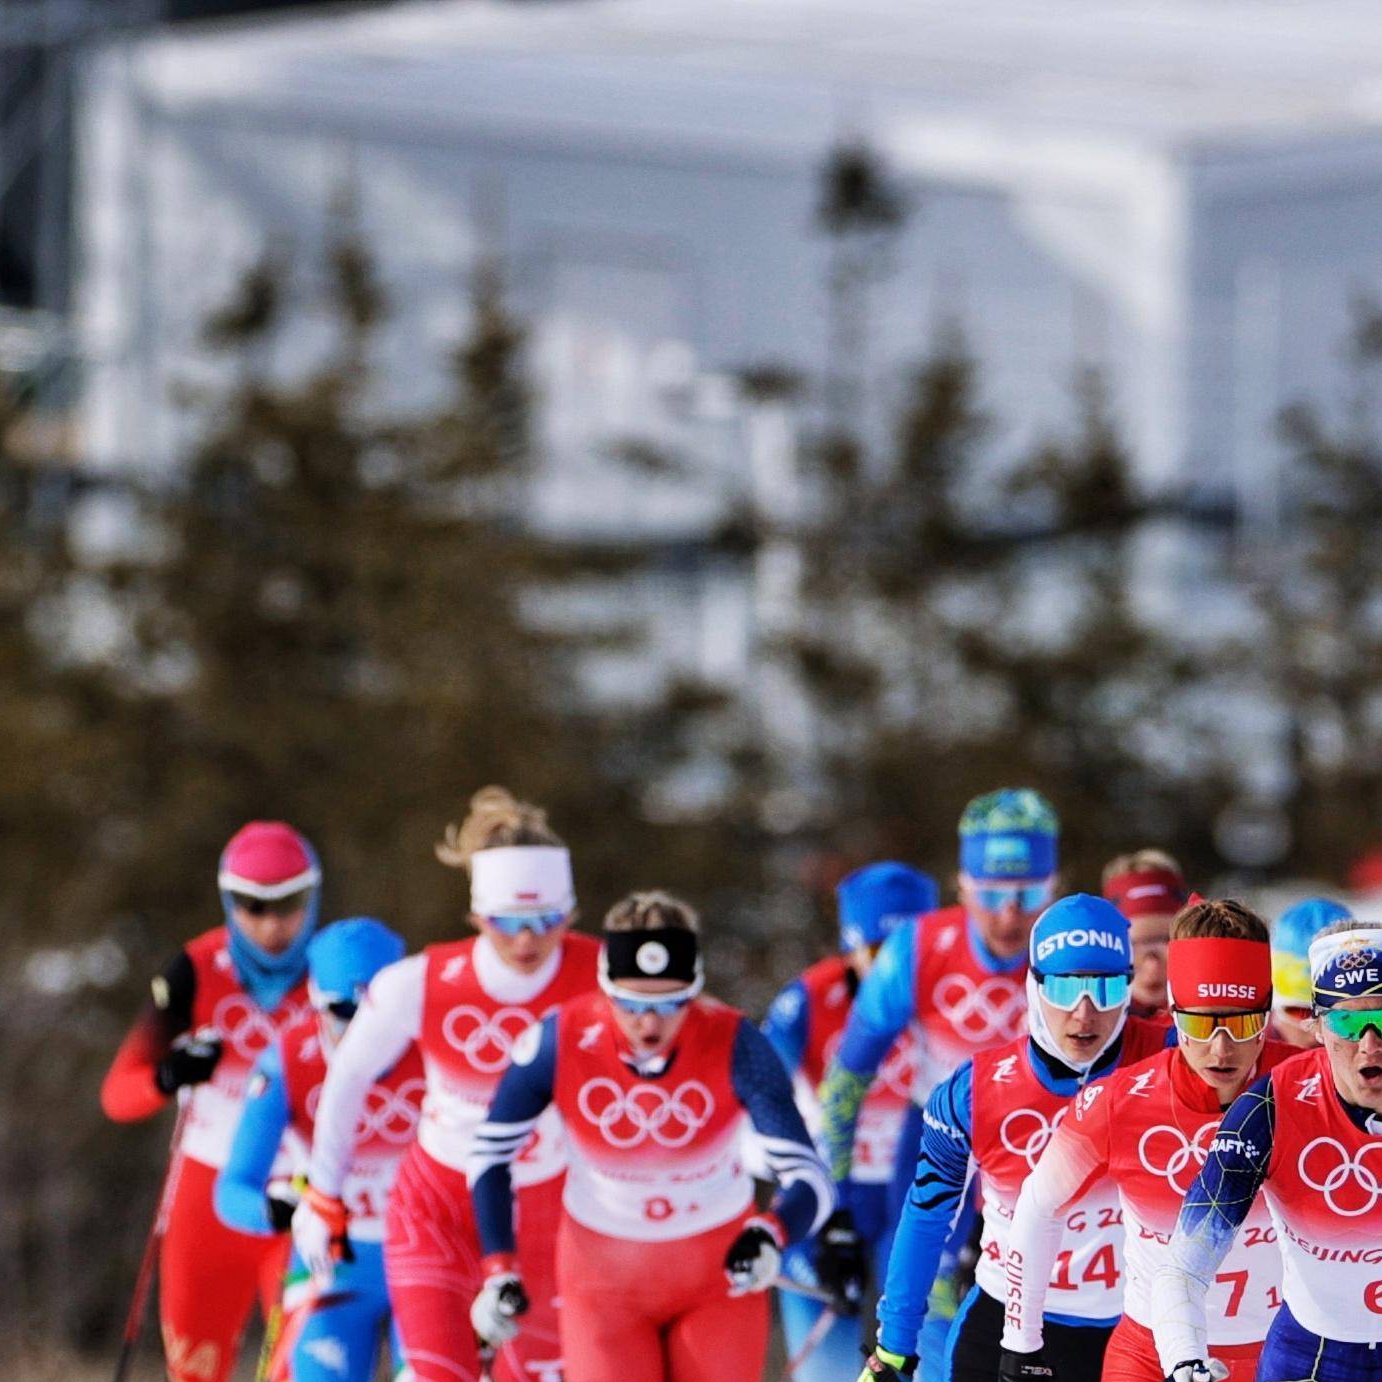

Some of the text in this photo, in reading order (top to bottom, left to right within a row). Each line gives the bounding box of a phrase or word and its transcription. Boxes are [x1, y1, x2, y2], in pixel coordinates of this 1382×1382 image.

[1037, 929, 1125, 961] ESTONIA
[1197, 983, 1256, 1000] SUISSE
[1334, 968, 1380, 990] SWE
[1049, 1243, 1121, 1291] 14
[1006, 1249, 1023, 1331] SUISSE
[1215, 1270, 1249, 1317] 7
